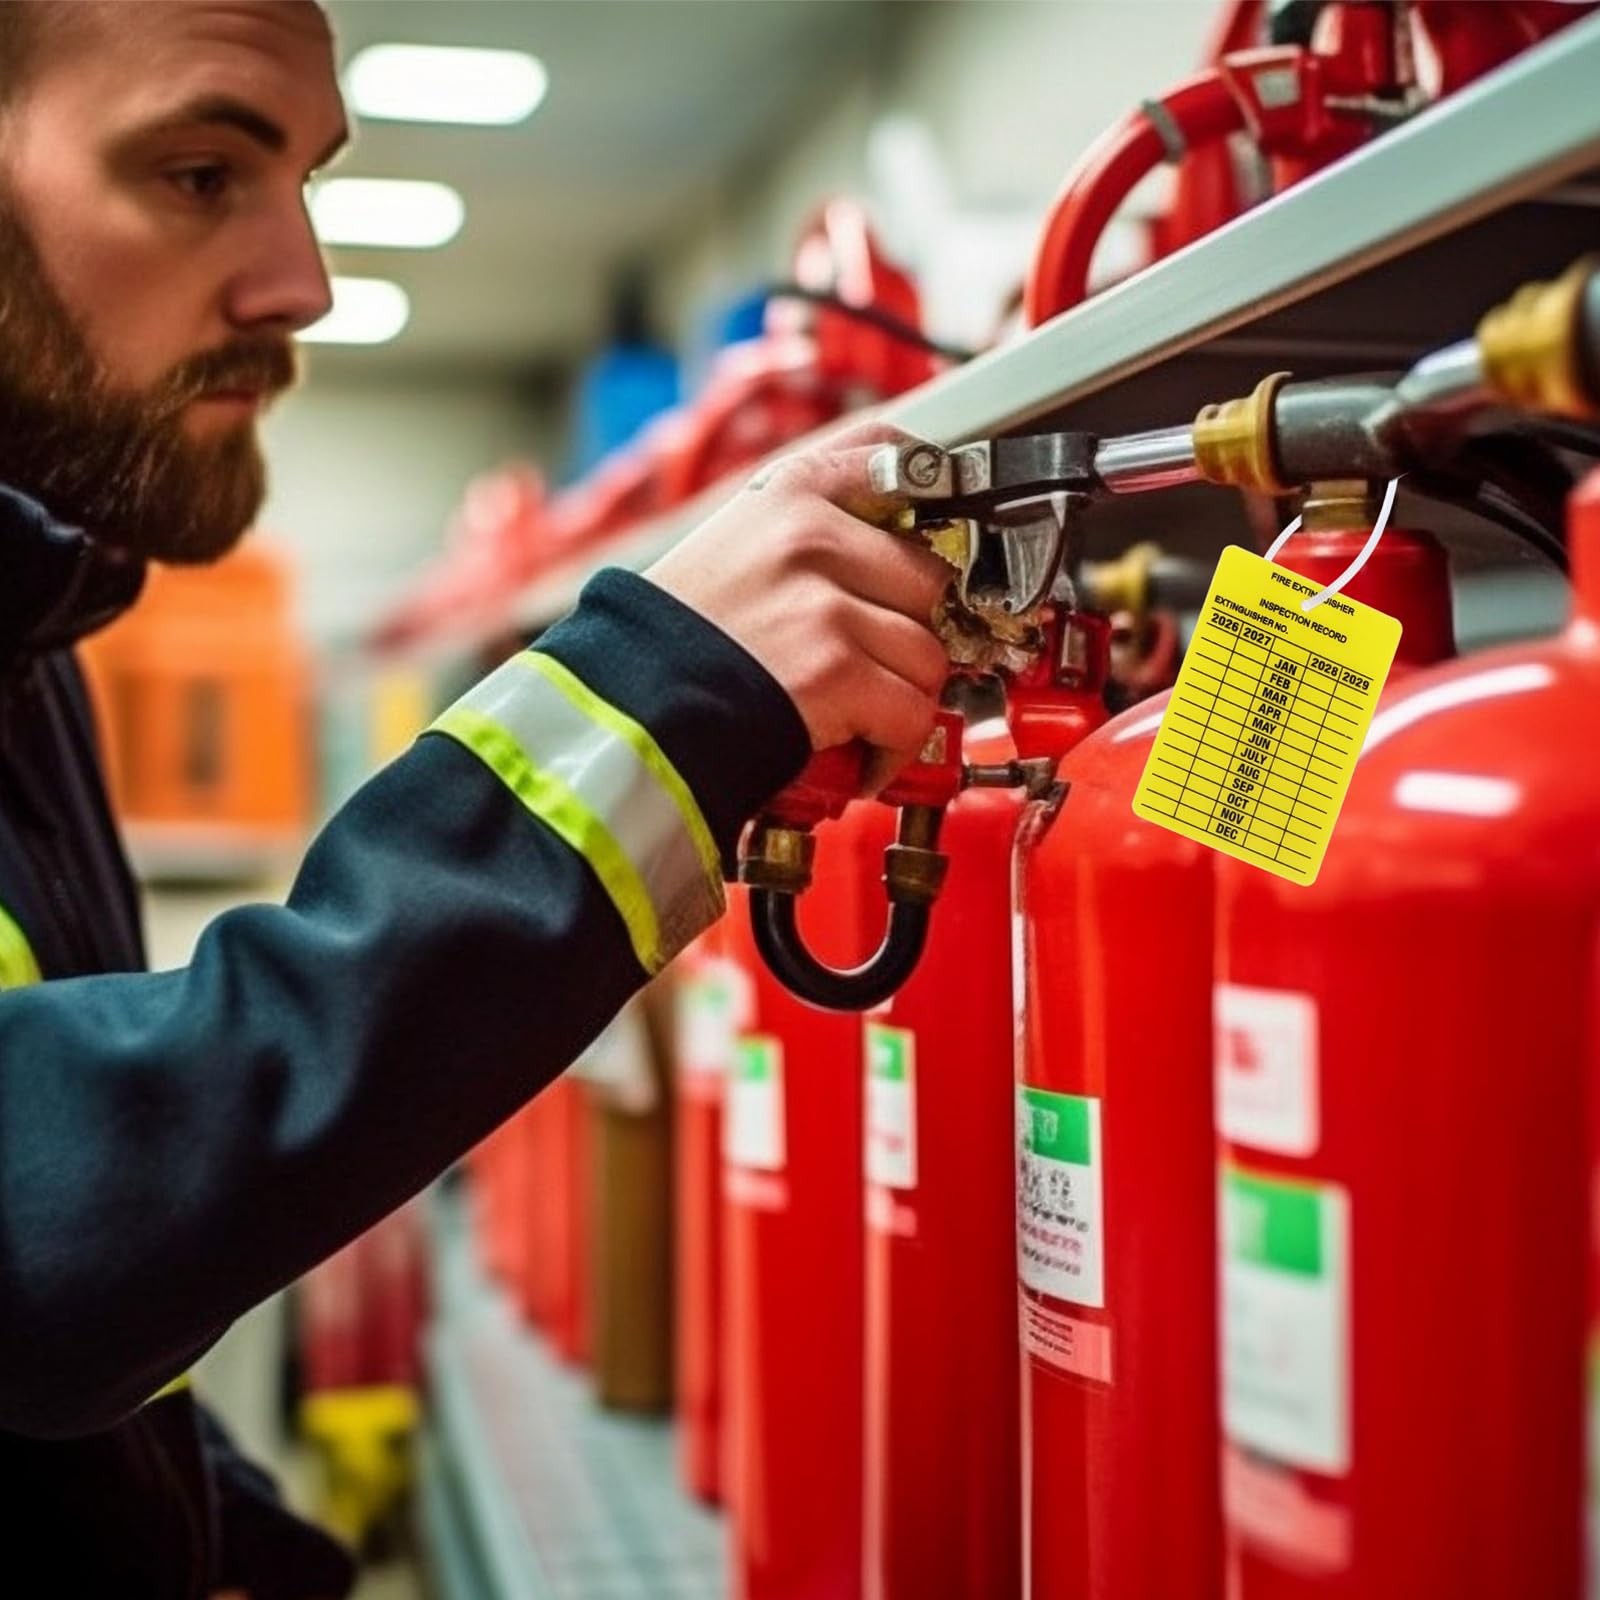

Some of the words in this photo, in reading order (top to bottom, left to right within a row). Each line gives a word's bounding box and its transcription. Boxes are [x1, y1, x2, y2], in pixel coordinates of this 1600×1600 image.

[1272, 572, 1291, 587] FIRE
[1292, 580, 1355, 616] EXTINUISHER
[1215, 596, 1274, 628] EXTINGUISHER
[1273, 620, 1289, 634] NO.
[1260, 599, 1311, 628] INSPECTION
[1311, 620, 1347, 644] RECORD
[1211, 614, 1239, 633] 2026
[1243, 627, 1271, 646] 2027
[1311, 658, 1339, 677] 2028
[1342, 672, 1370, 690] 2029
[1274, 659, 1297, 675] JAN
[1269, 673, 1291, 689] FEB
[1262, 688, 1288, 706] MAR
[1258, 704, 1282, 720] APR
[1252, 717, 1276, 735] MAY
[1247, 734, 1271, 750] JUN
[1240, 748, 1268, 766] JULY
[1237, 763, 1260, 780] AUG
[1232, 778, 1255, 793] SEP
[1227, 793, 1250, 810] OCT
[1220, 808, 1244, 825] NOV
[1216, 823, 1239, 840] DEC
